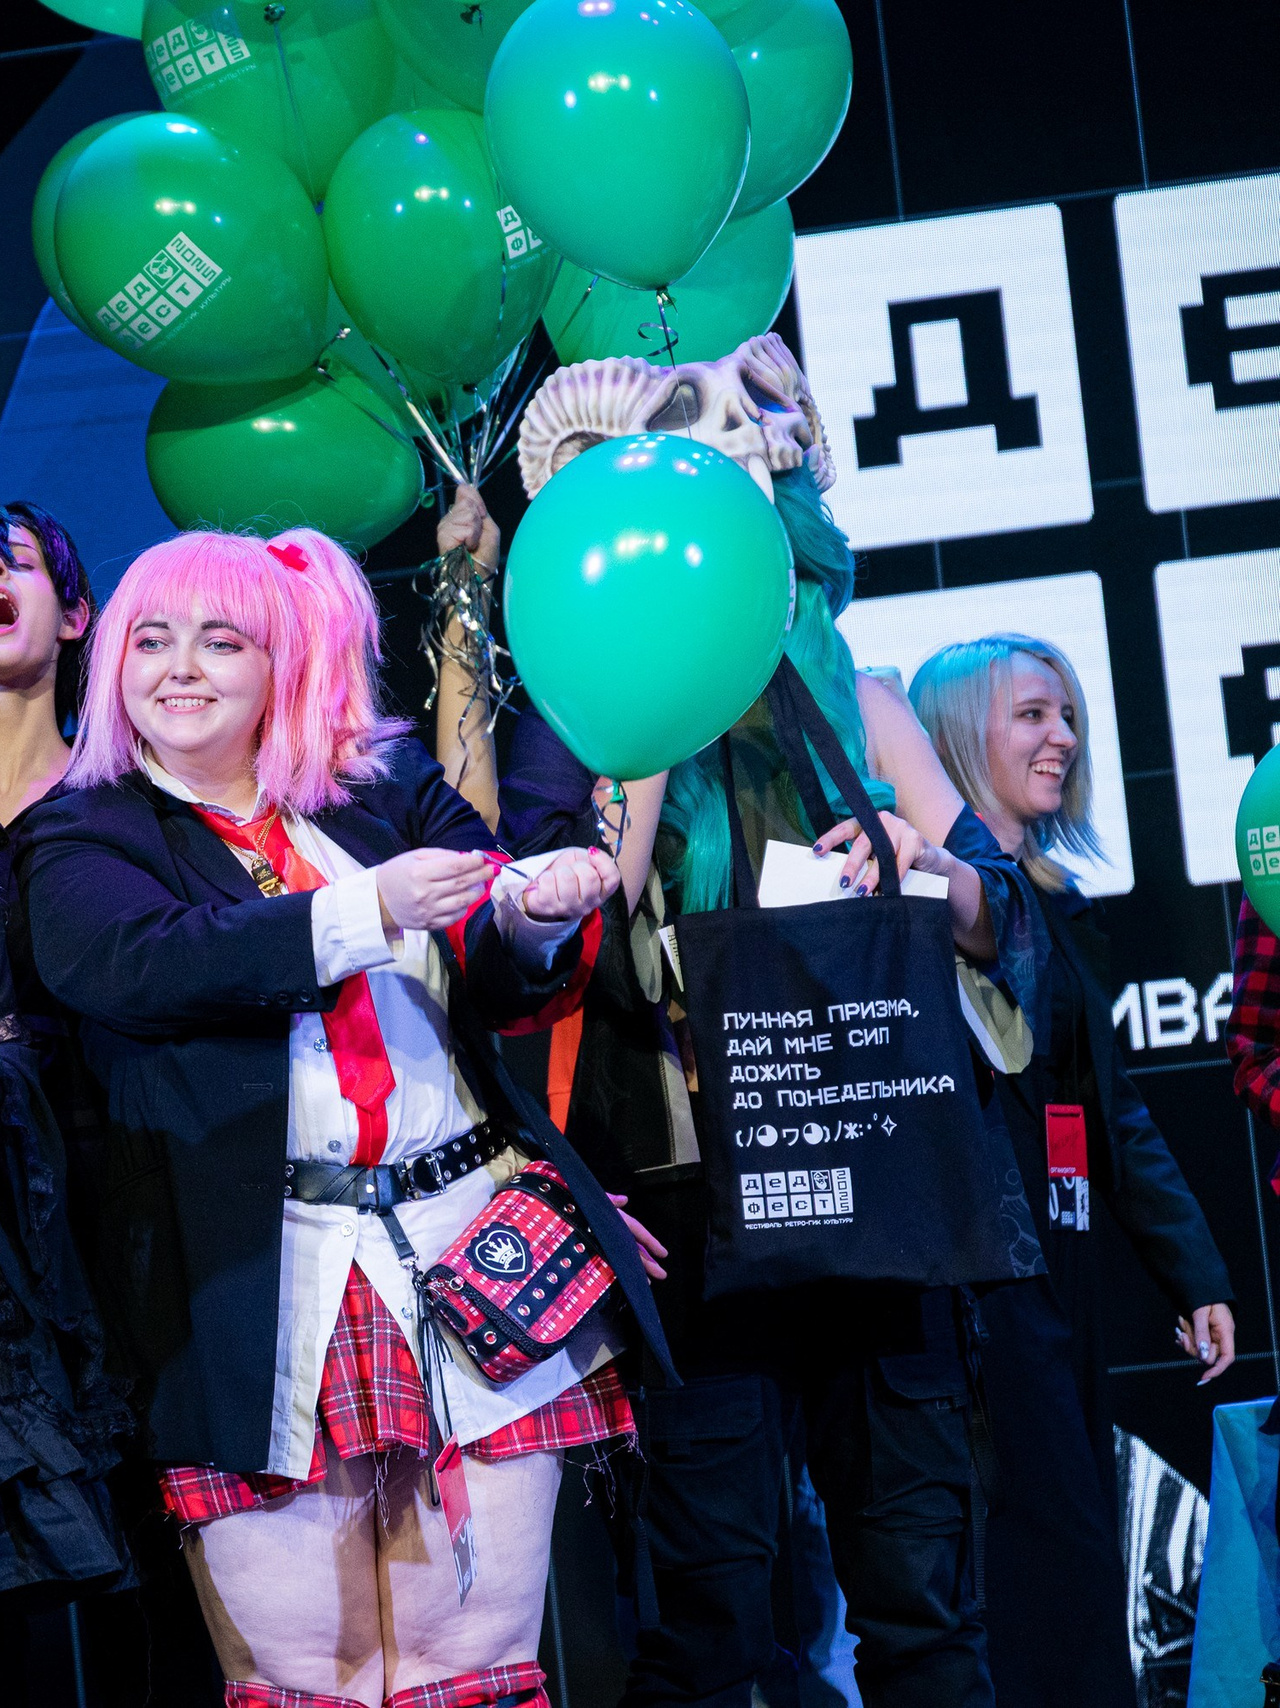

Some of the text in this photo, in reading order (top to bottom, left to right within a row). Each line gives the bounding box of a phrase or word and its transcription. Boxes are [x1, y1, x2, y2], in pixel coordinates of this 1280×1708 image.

[169, 236, 219, 283] 2025
[723, 998, 920, 1031] ЛУННАЯ ПРИЗМА,
[726, 1026, 890, 1057] ДАЙ МНЕ СИЛ
[729, 1063, 821, 1084] ДОЖИТЬ
[733, 1074, 956, 1110] ДО ПОНЕДЕЛЬНИКА
[834, 1168, 851, 1213] 2025
[784, 1219, 822, 1228] РЕТРО-ГИК
